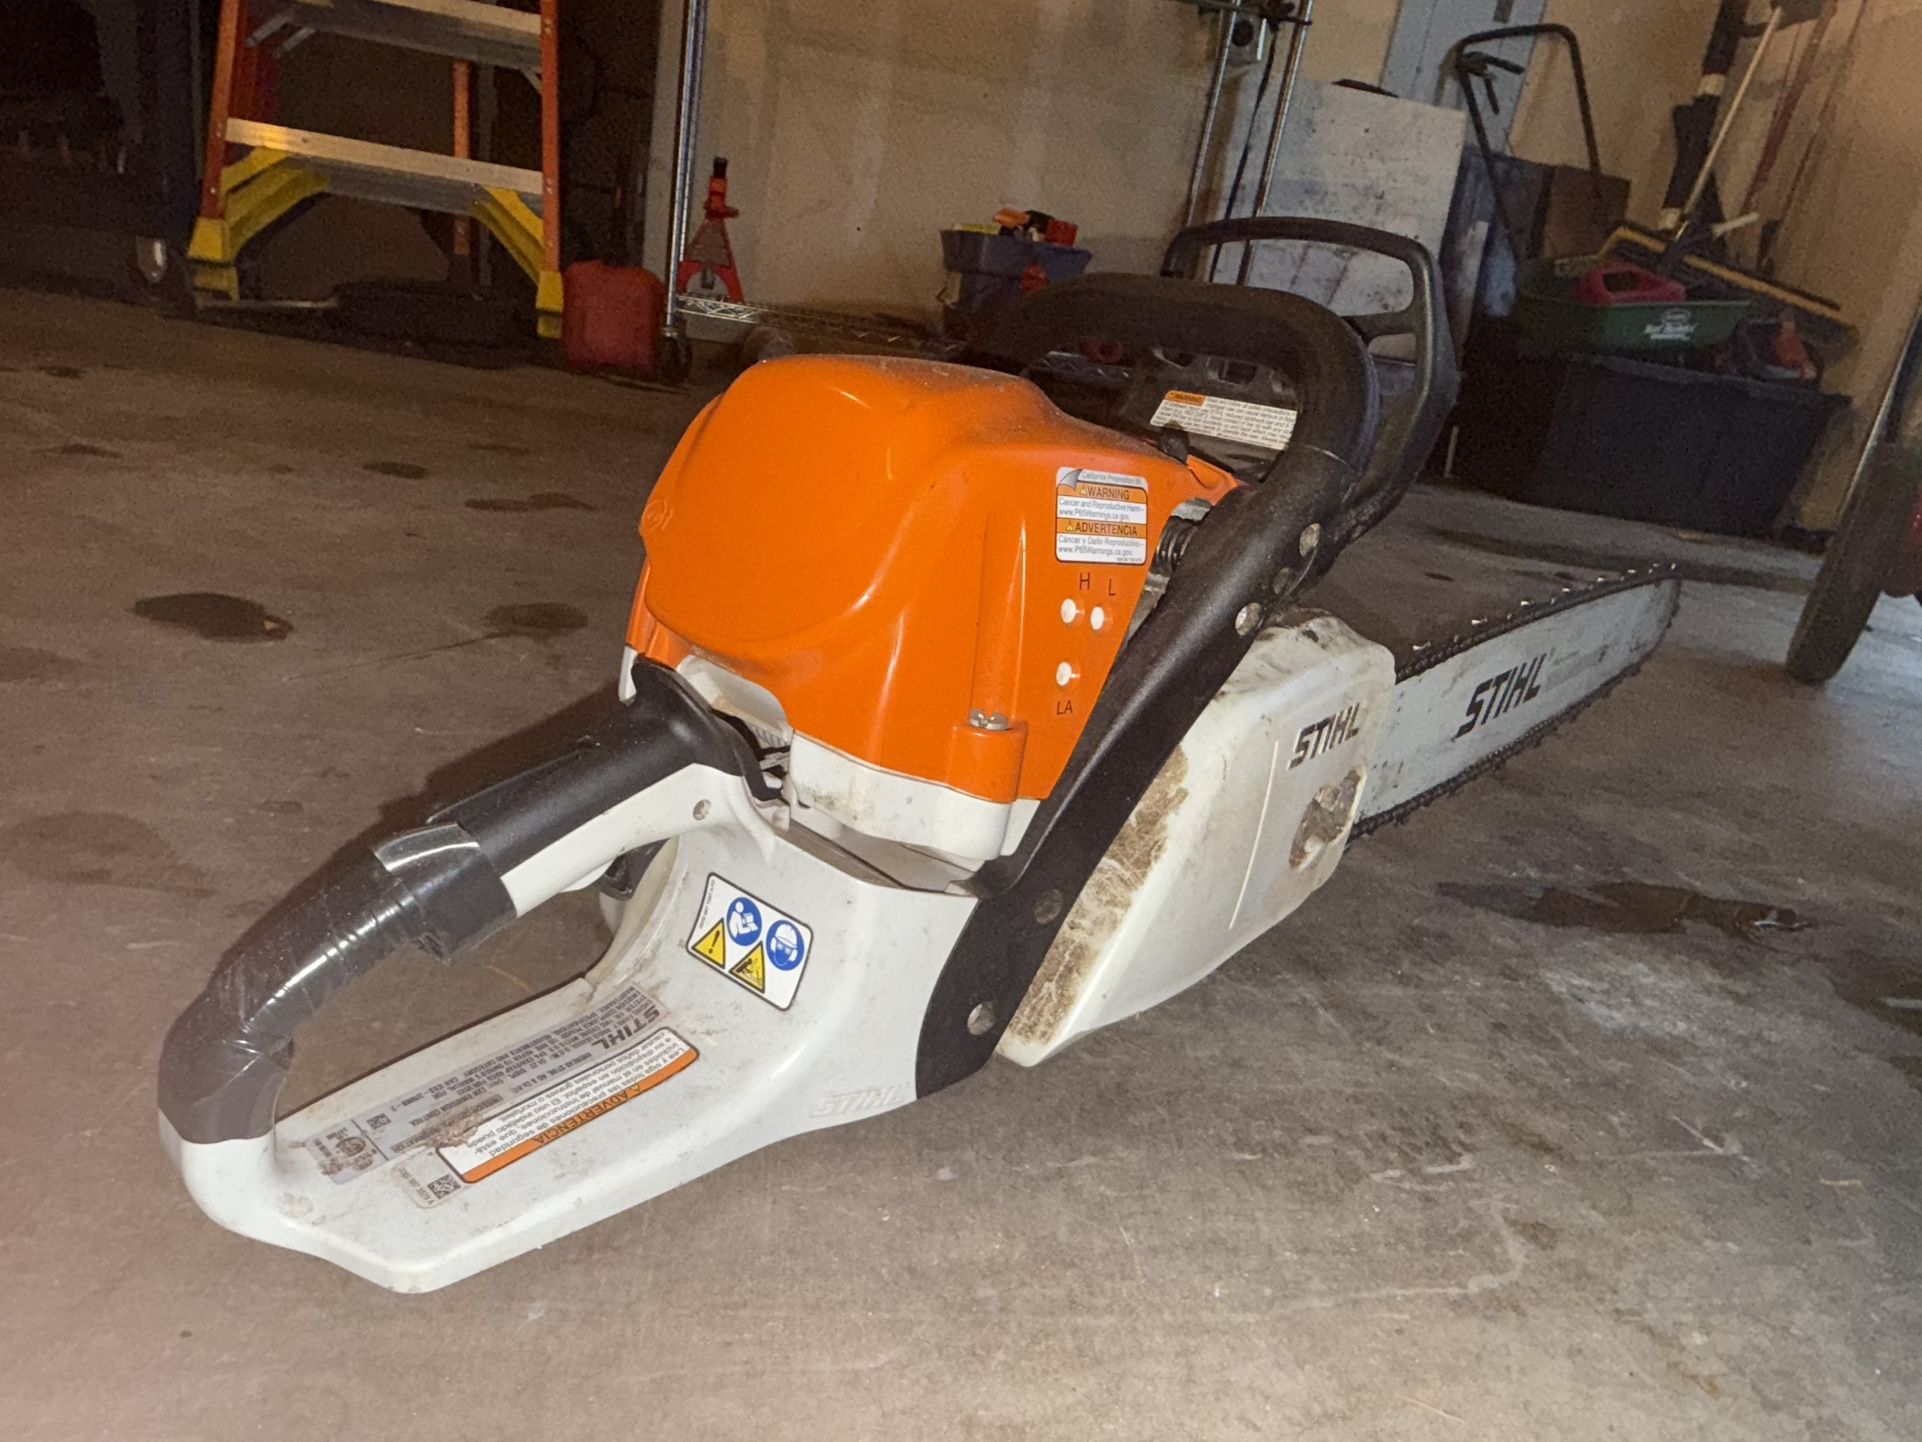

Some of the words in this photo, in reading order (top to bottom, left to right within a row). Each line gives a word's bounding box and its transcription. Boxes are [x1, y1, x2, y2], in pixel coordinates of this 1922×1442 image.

[1087, 486, 1130, 500] WARNING
[1075, 521, 1138, 536] ADVERTENCIA
[1079, 572, 1090, 590] H
[1108, 579, 1116, 596] L
[1056, 700, 1073, 715] LA
[1451, 652, 1547, 742] STIHL
[1286, 702, 1361, 770] STIHL
[592, 1005, 660, 1050] STIHL
[668, 1046, 685, 1060] Lea
[579, 1089, 591, 1100] de
[591, 1073, 623, 1094] manual
[532, 1089, 628, 1146] ADVERTENCIA
[548, 1090, 607, 1125] precauciones
[536, 1121, 549, 1132] de
[488, 1128, 535, 1157] seguridad
